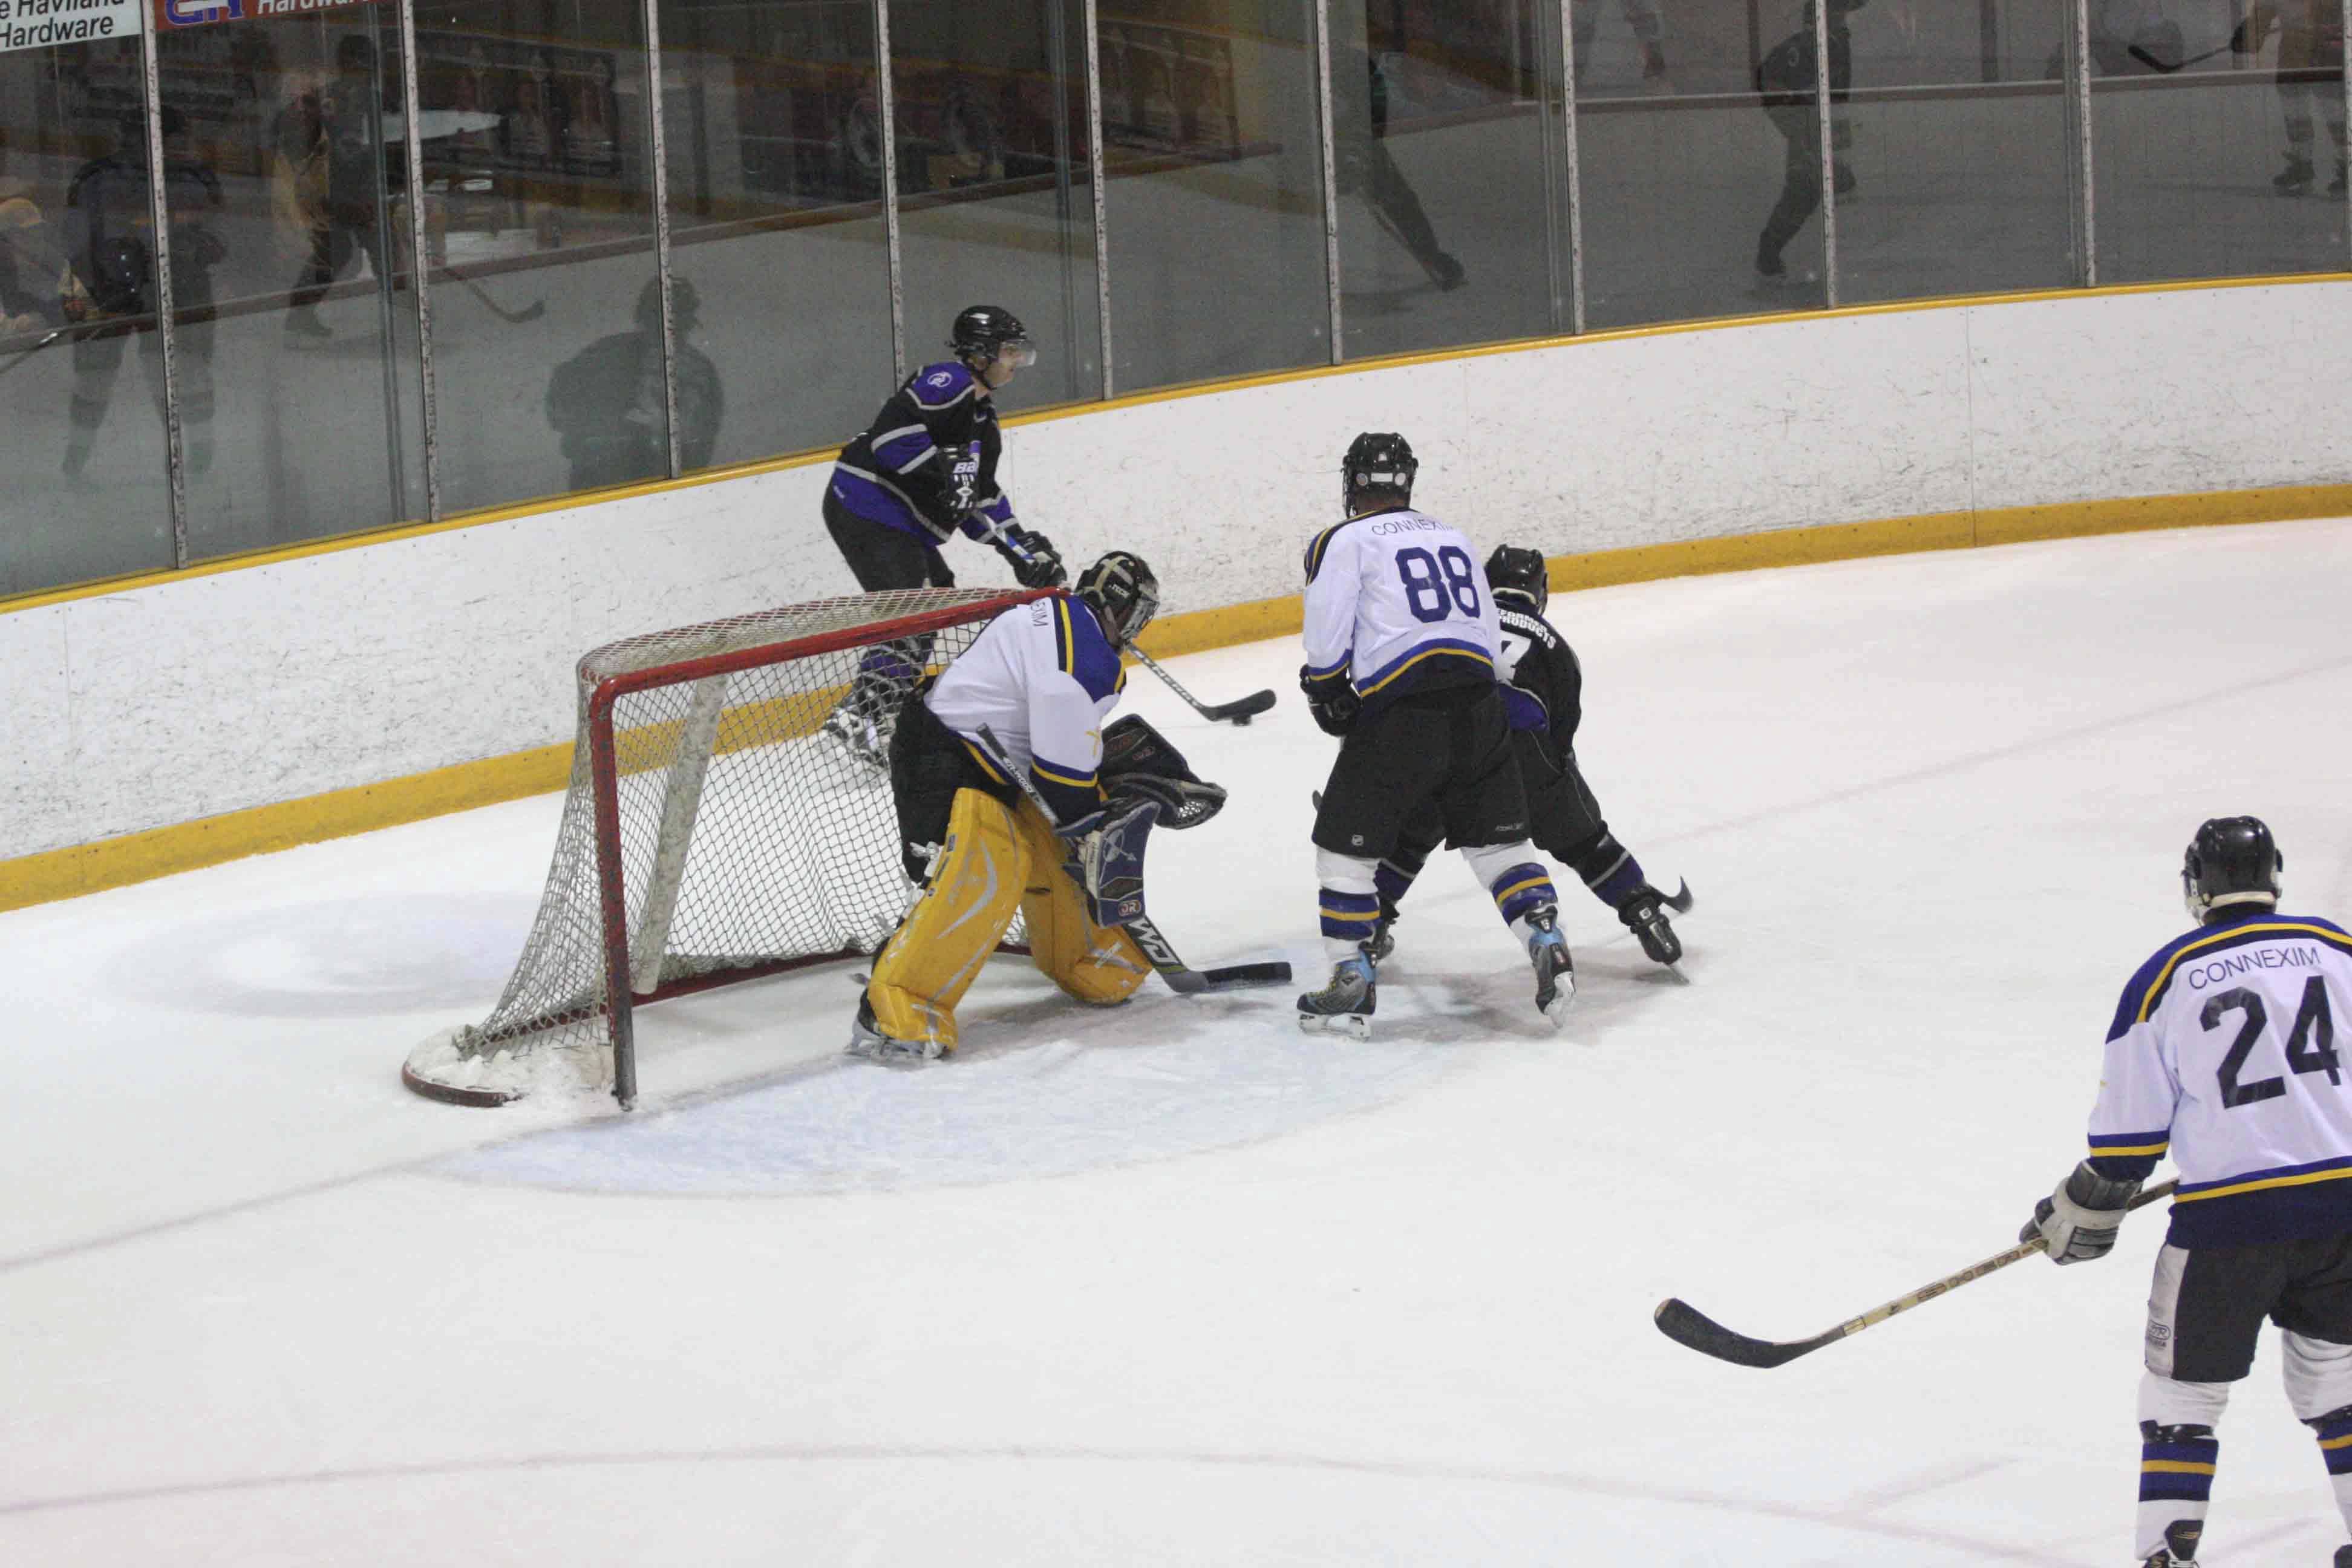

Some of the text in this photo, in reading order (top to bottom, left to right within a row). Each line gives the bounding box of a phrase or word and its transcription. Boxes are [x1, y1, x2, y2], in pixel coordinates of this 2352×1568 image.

[18, 0, 124, 18] Havi
[0, 16, 114, 48] Hardware
[1395, 545, 1481, 624] 88
[2189, 947, 2321, 990] CONNEXIM
[2200, 975, 2342, 1109] 24
